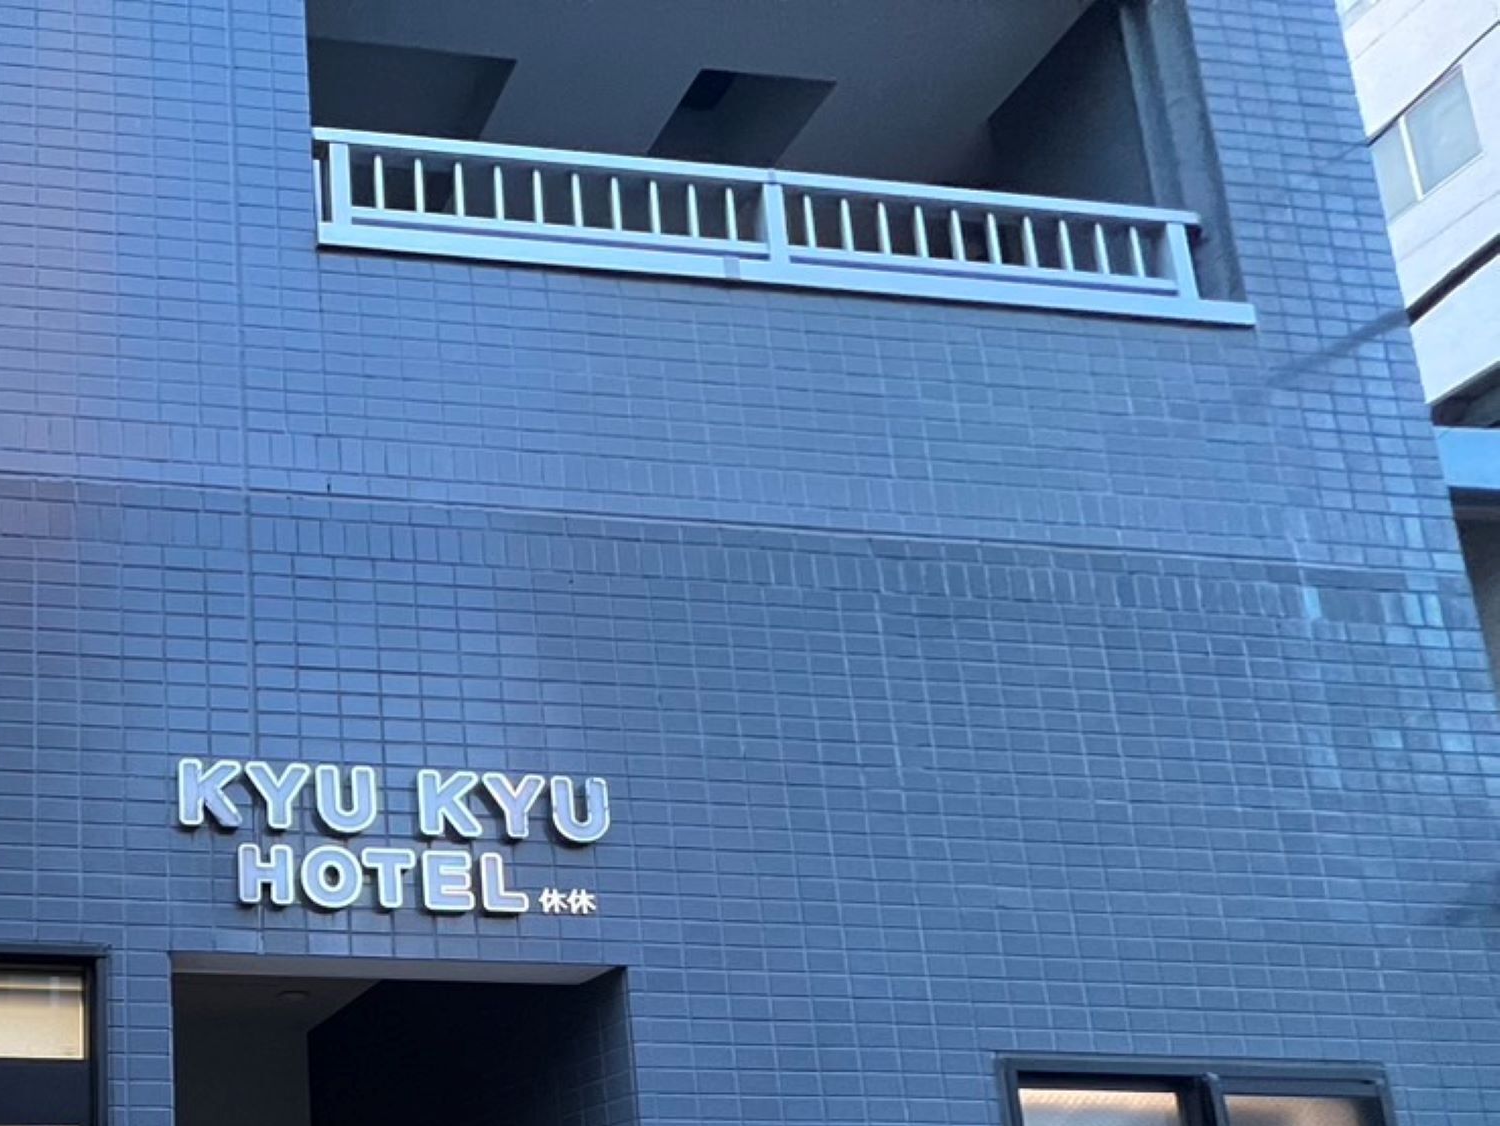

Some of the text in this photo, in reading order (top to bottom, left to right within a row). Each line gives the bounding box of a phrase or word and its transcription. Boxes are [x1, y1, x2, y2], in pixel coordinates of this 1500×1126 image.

[178, 757, 610, 843] KYU KYU
[237, 844, 597, 915] HOTEL 休休
